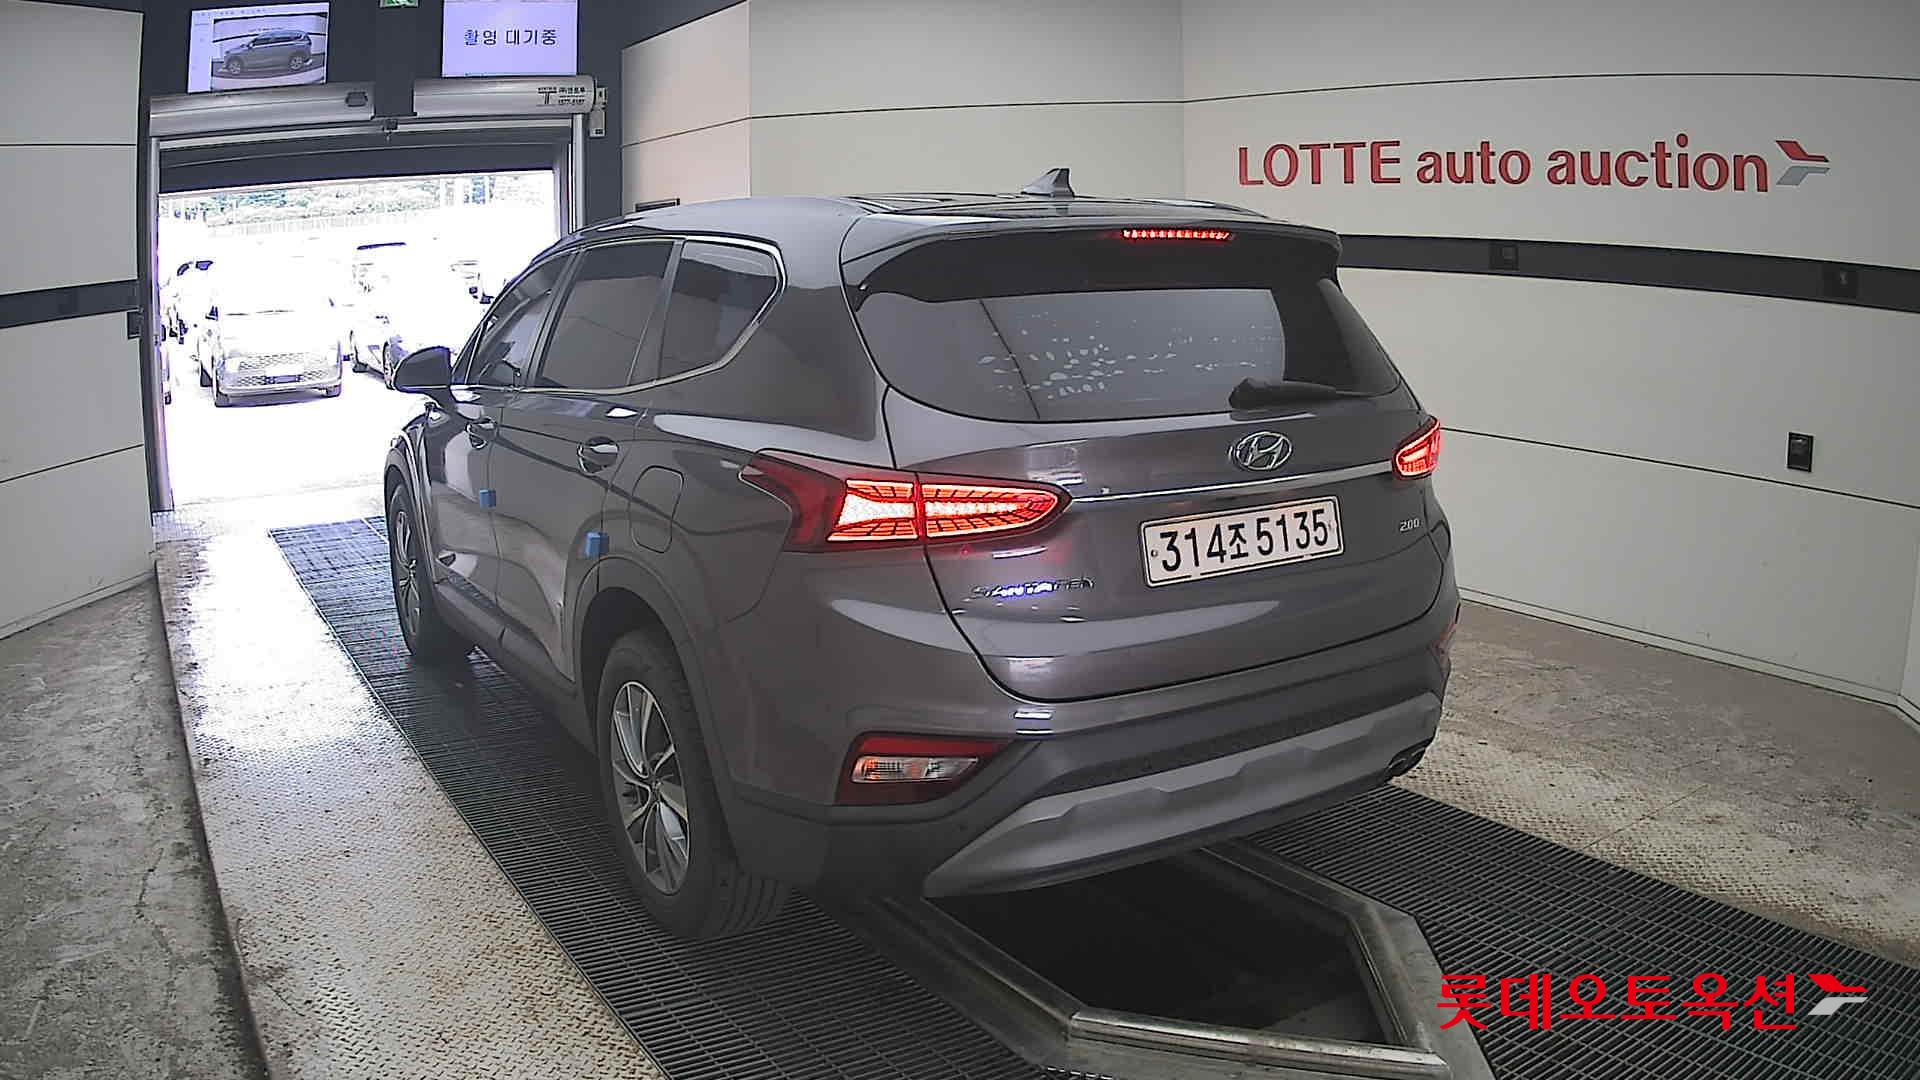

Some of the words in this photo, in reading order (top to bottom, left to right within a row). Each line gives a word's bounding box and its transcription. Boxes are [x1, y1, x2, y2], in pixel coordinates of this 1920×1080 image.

[505, 29, 557, 46] 대기중
[1238, 140, 1401, 187] LOTTE
[1416, 141, 1531, 184] auto
[1547, 133, 1768, 192] auction
[1160, 522, 1249, 572] 314조
[1256, 508, 1328, 556] 5135
